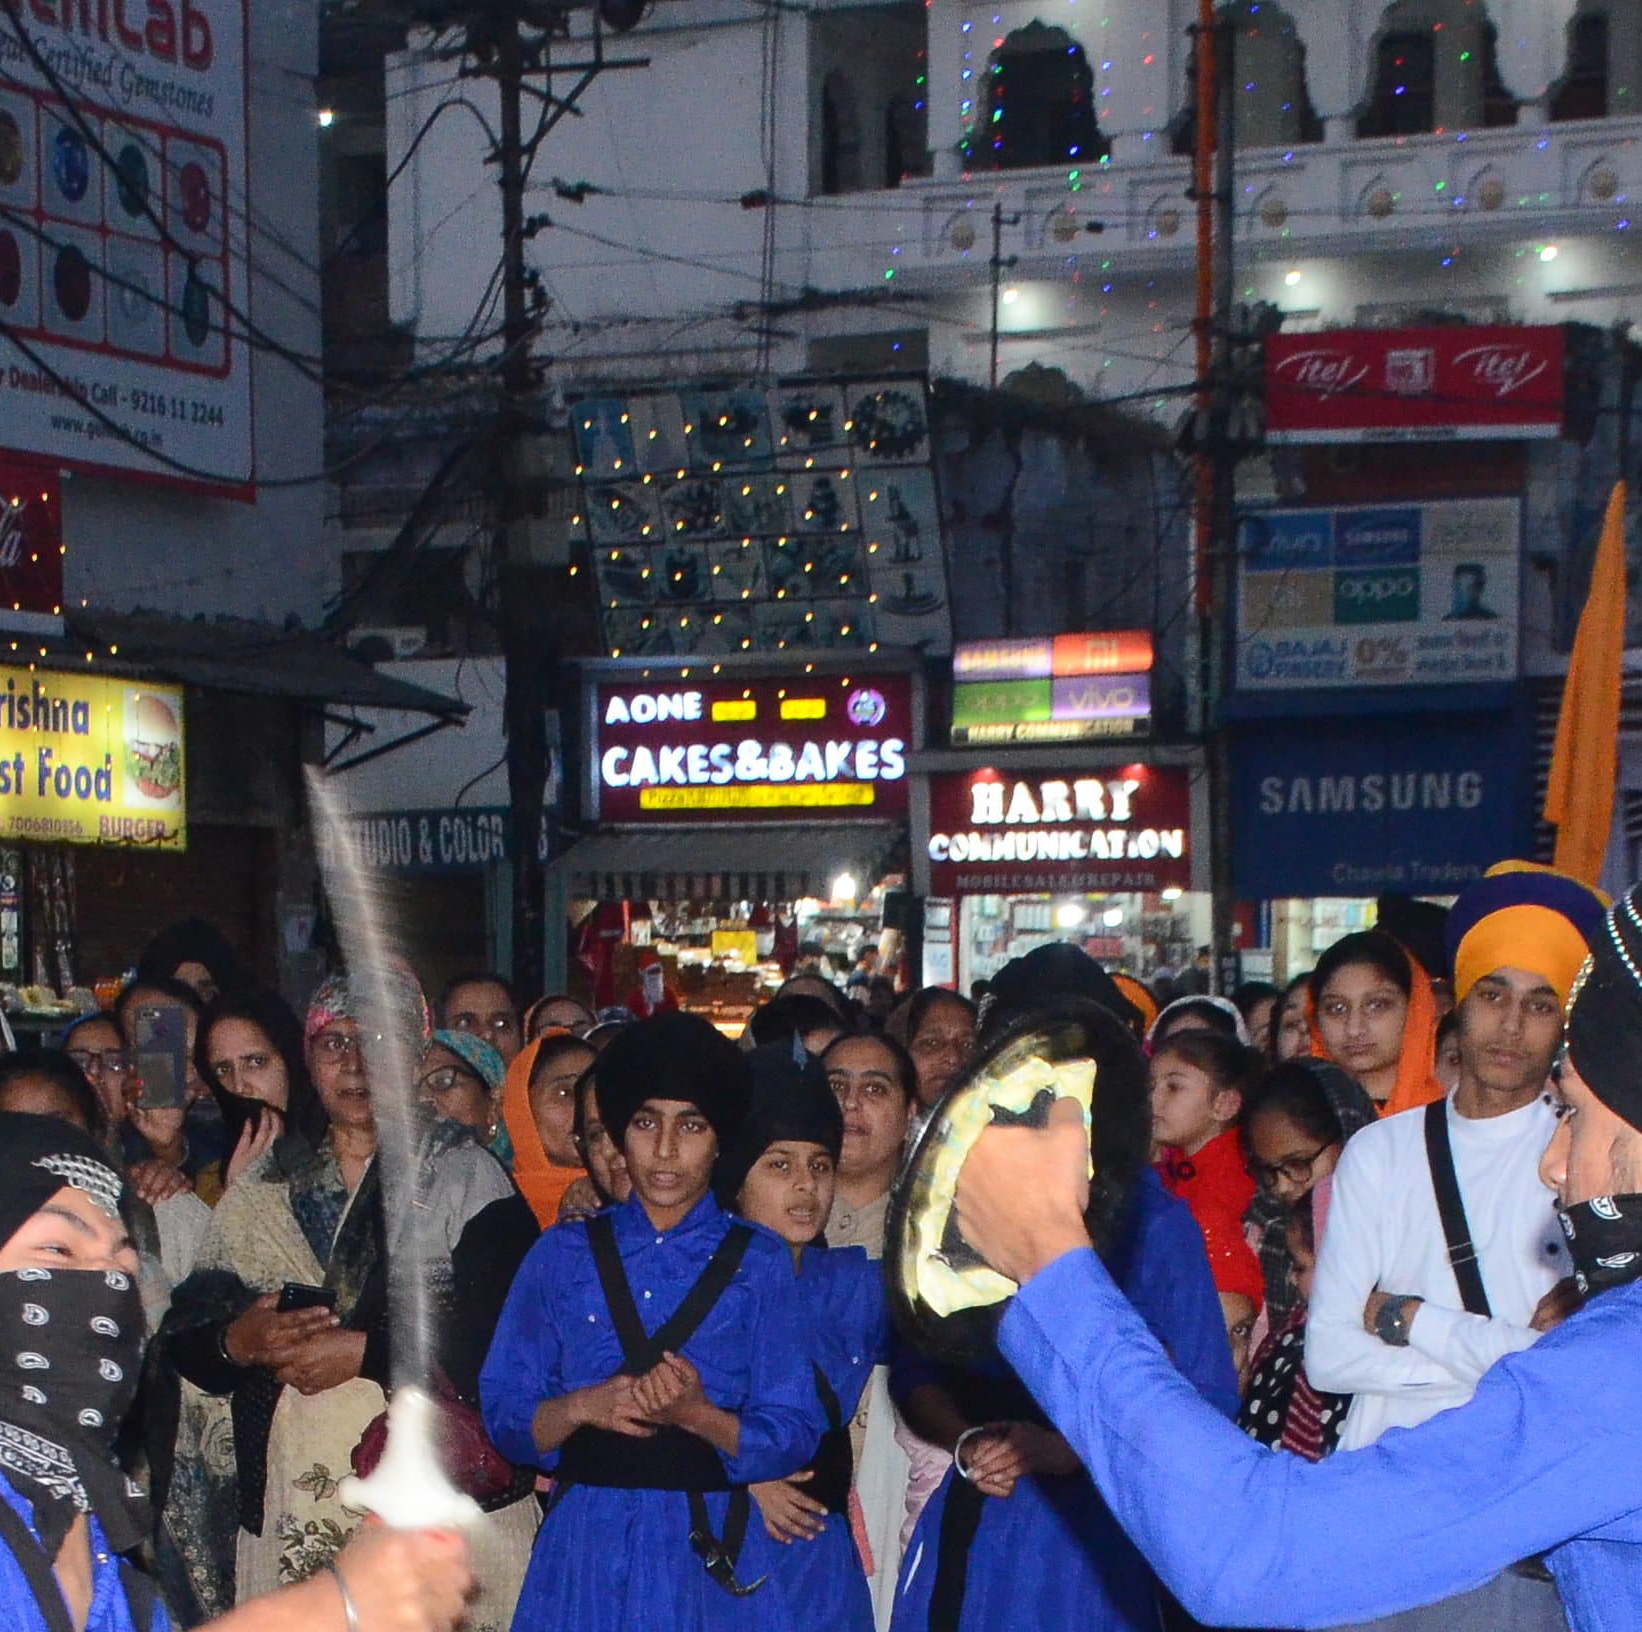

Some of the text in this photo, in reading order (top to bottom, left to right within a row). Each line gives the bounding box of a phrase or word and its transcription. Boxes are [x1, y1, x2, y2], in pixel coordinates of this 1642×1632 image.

[91, 382, 118, 407] Call
[131, 387, 166, 418] 9216
[605, 691, 702, 724] AONE
[38, 747, 112, 803] Food
[601, 739, 906, 787] CAKES&BAKES
[970, 779, 1140, 824] HARRY
[1260, 771, 1483, 815] SAMSUNG
[99, 814, 166, 840] BURGER
[418, 816, 434, 865] &
